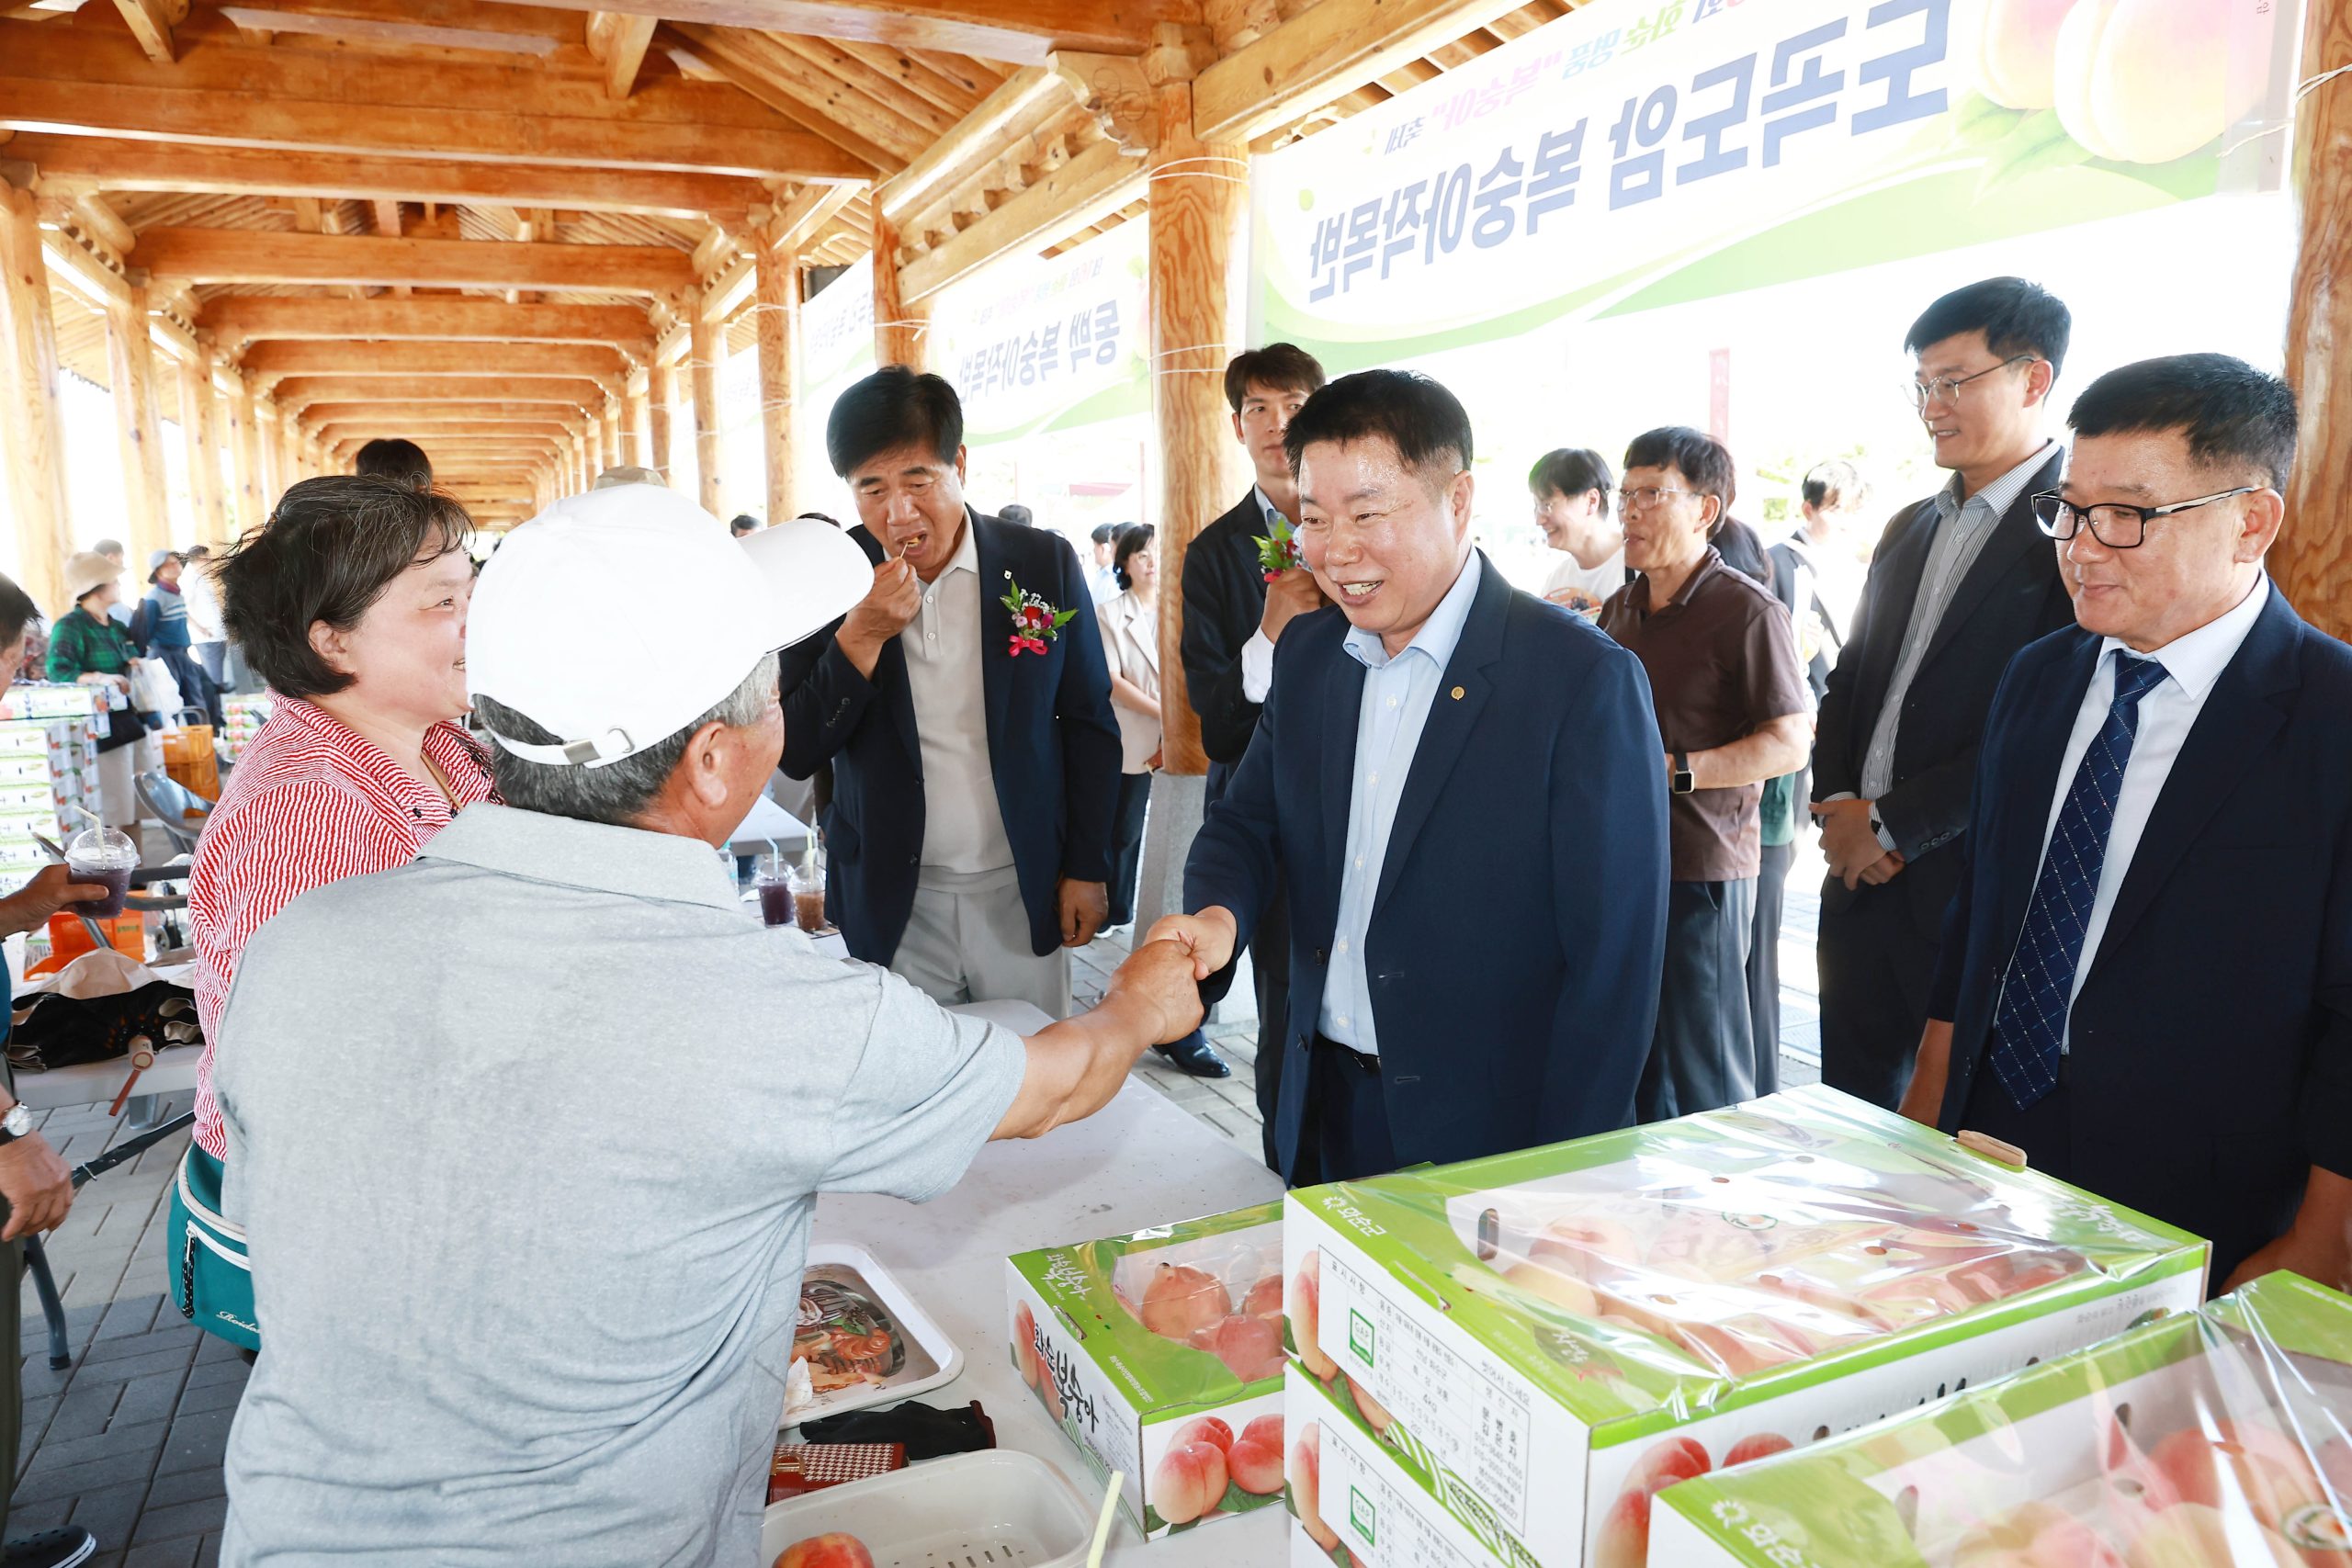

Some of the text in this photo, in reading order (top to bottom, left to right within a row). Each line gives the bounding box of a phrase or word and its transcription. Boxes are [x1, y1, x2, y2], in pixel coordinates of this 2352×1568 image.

[1338, 1207, 1387, 1237] 화순군
[1035, 1323, 1099, 1433] 화순복숭아
[1740, 1524, 1821, 1568] 화순
